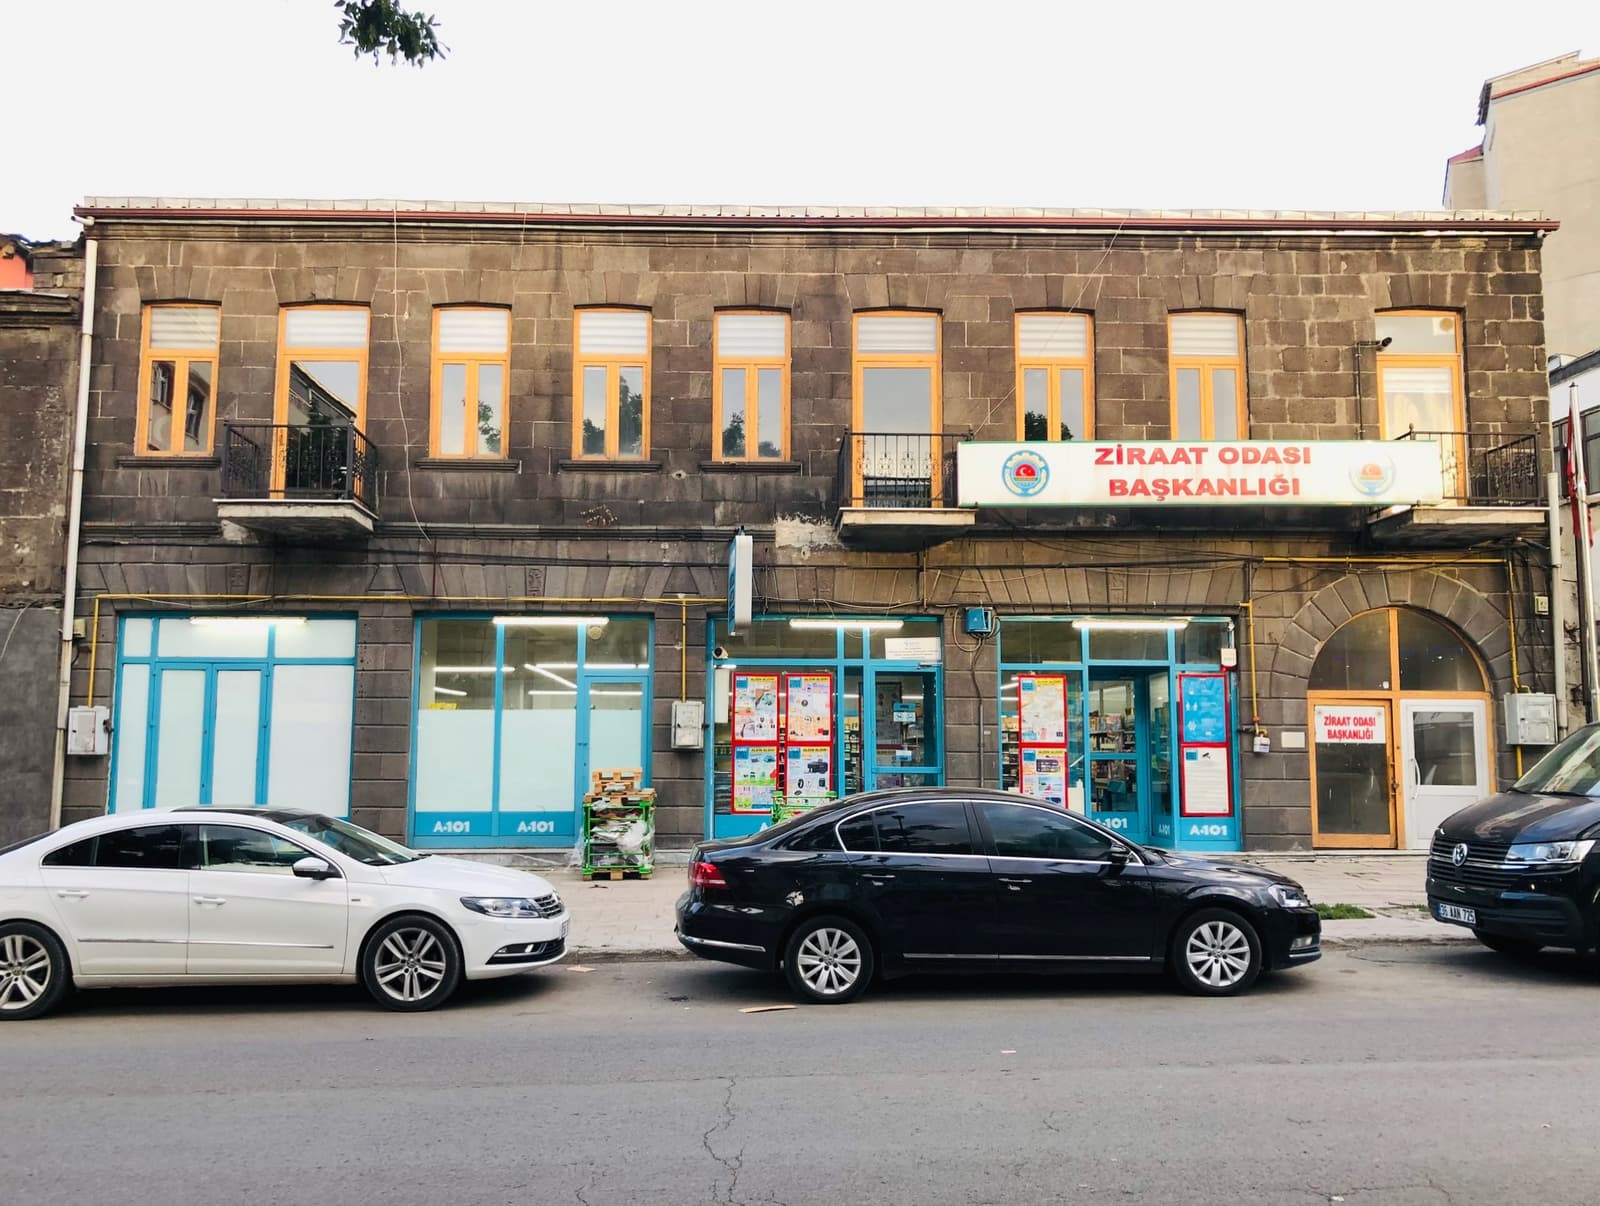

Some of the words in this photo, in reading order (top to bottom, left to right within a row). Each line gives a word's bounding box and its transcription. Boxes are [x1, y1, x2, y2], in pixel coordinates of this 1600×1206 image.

[1095, 444, 1208, 465] ZİRAAT
[1218, 447, 1311, 465] ODASI
[1109, 474, 1299, 501] BAŞKANLIĞI
[1324, 714, 1350, 726] ZİRAAT
[1353, 716, 1376, 726] ODASI
[1327, 728, 1373, 741] BAŞKANLIĞI
